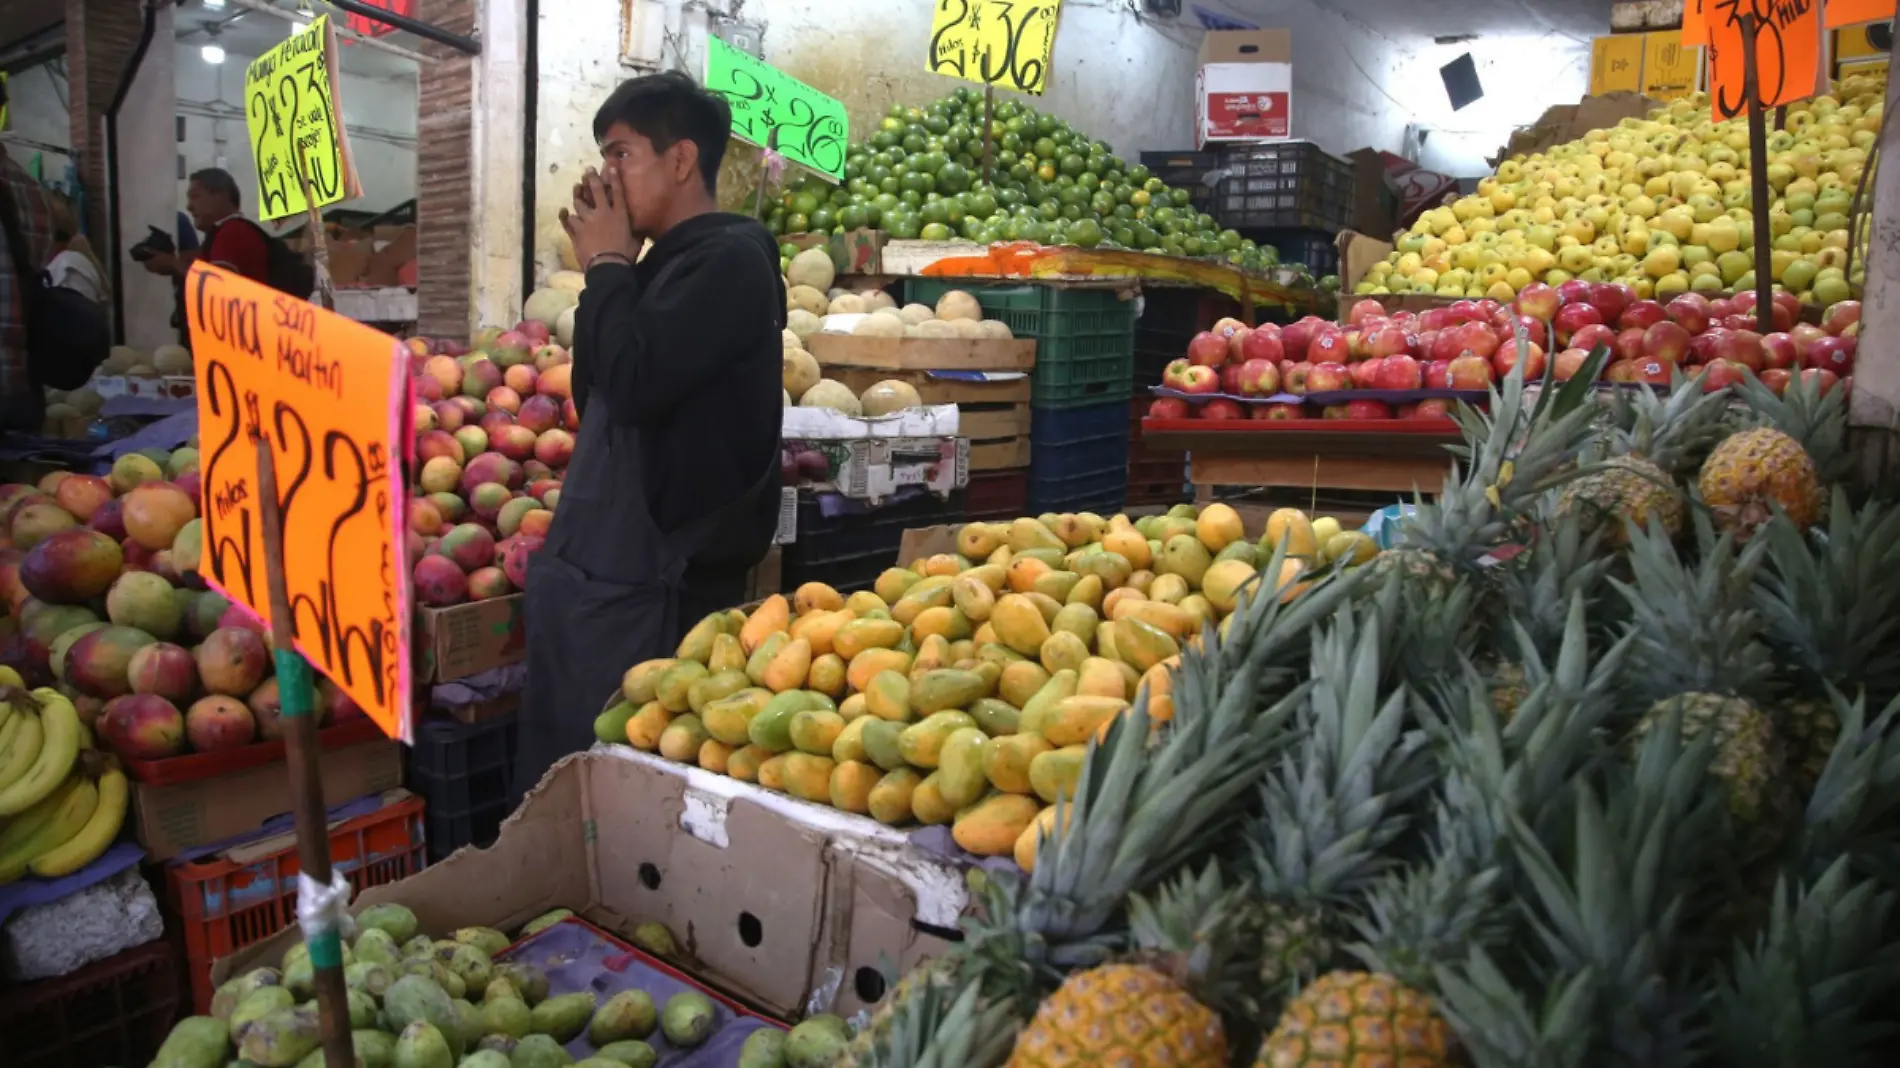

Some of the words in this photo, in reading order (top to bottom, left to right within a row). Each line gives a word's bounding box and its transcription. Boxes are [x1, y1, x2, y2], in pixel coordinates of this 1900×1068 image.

[929, 0, 968, 77] 2
[980, 0, 1041, 90] 36
[252, 91, 289, 216] 2
[774, 97, 843, 173] 26
[191, 268, 263, 360] Tuna
[204, 360, 255, 609] 2
